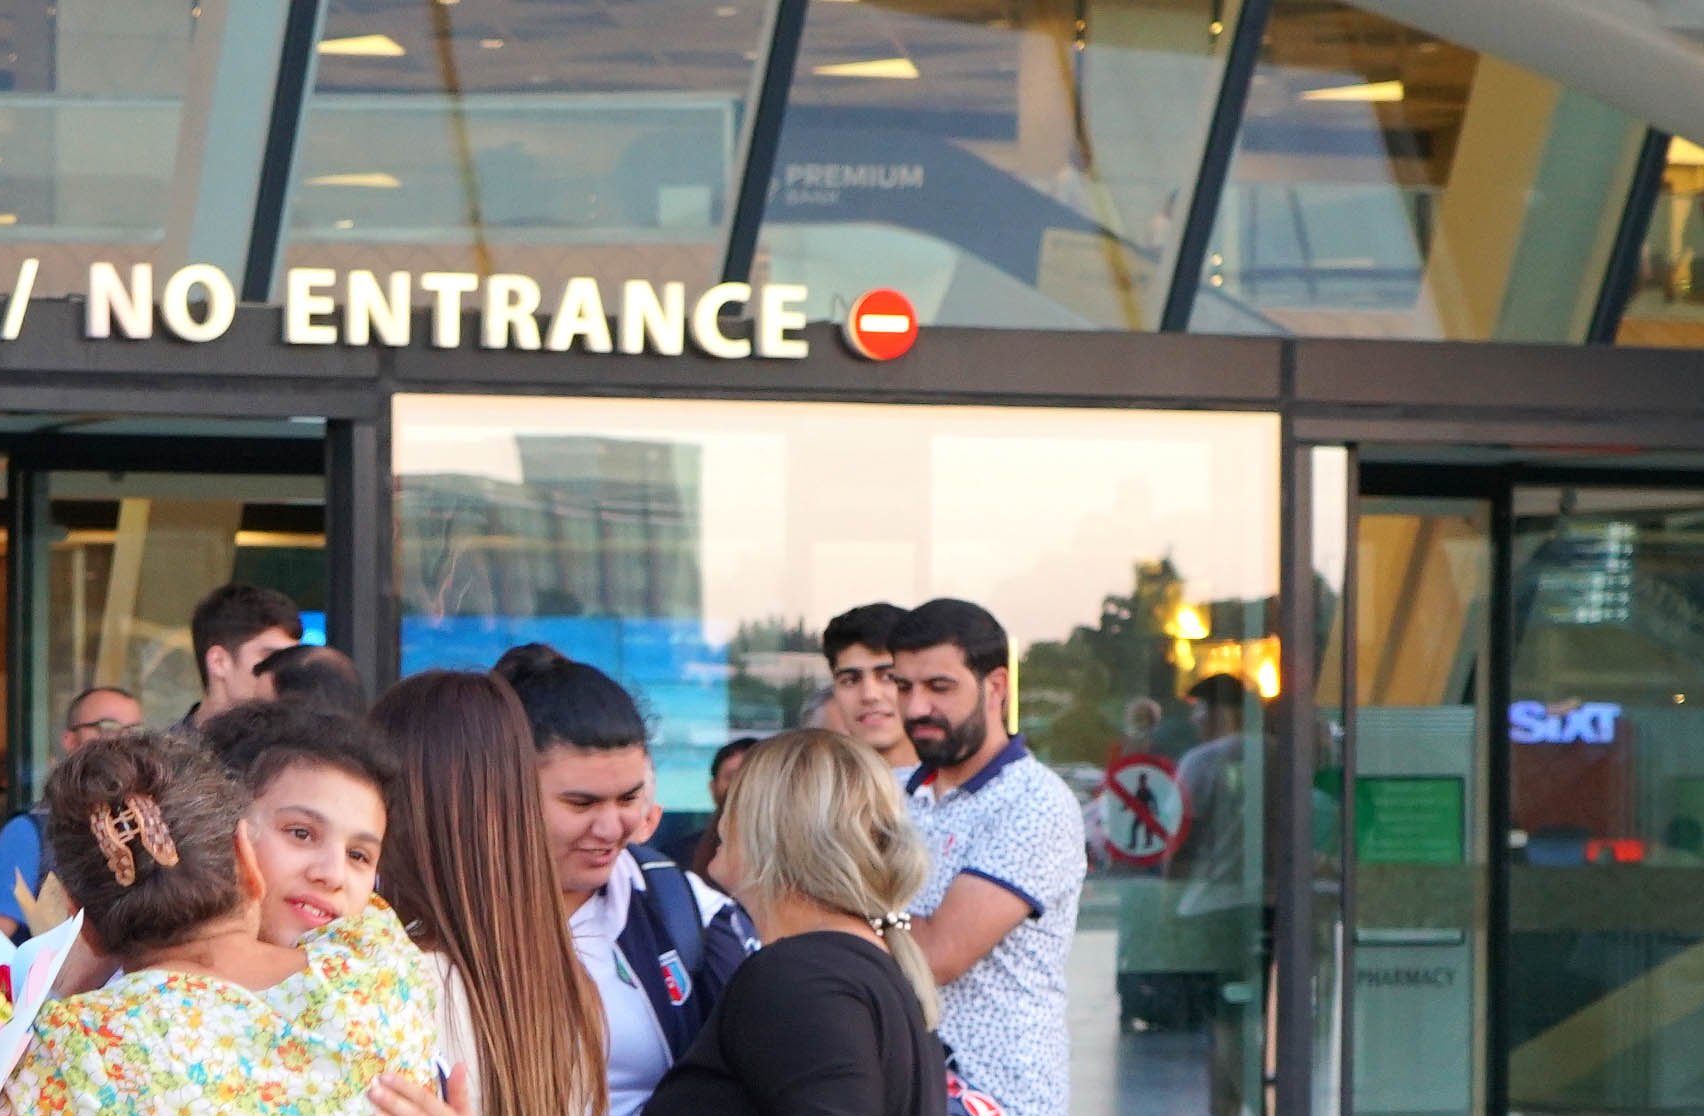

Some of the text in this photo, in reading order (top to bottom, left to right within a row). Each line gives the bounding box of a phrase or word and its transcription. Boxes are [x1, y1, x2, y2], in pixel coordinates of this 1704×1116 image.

[784, 162, 925, 190] PREMIUM
[2, 259, 40, 341] /
[87, 262, 236, 343] NO
[284, 267, 810, 360] ENTRANCE
[1357, 968, 1457, 988] PHARMACY
